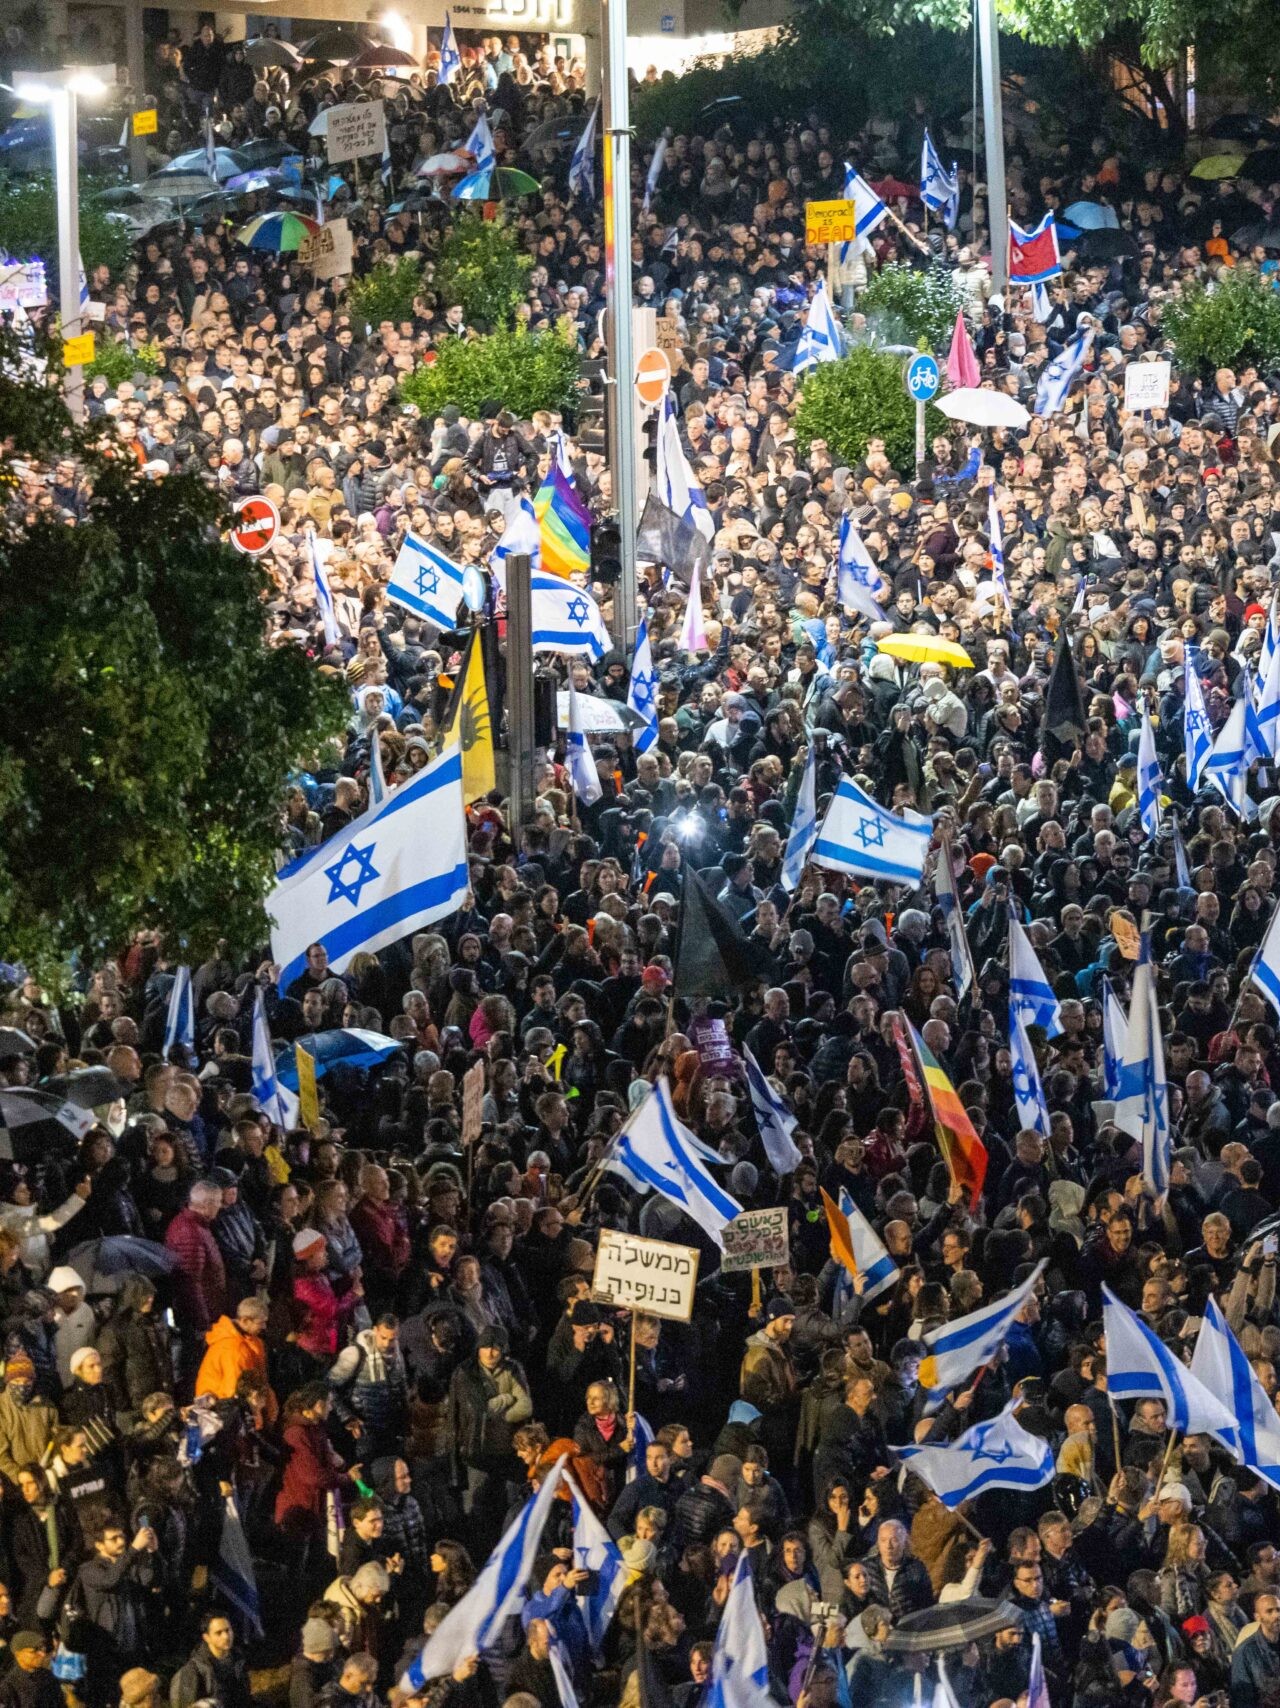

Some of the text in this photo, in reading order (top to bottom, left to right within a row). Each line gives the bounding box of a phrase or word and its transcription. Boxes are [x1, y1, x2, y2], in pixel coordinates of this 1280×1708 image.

[806, 225, 855, 243] DEAD
[764, 1235, 784, 1251] לא
[608, 1240, 690, 1275] ממשלה
[607, 1276, 681, 1305] כנופיה
